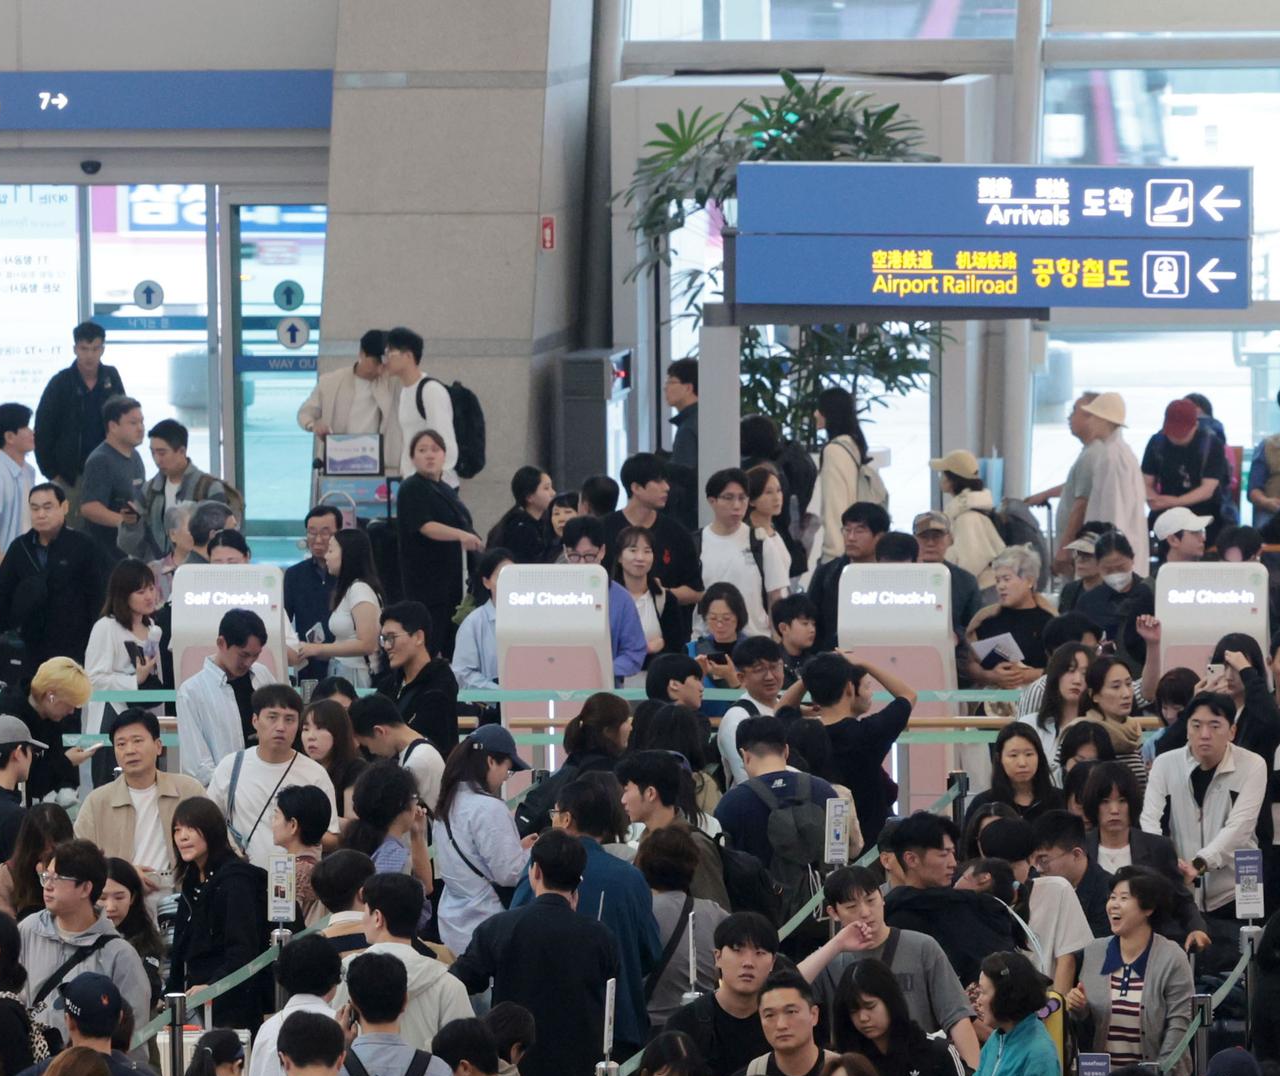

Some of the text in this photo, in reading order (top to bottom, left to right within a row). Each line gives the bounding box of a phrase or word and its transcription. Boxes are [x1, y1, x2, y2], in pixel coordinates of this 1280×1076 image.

[39, 92, 50, 109] 7
[1082, 187, 1134, 218] 도착
[985, 204, 1070, 226] Arrivals
[1031, 258, 1131, 289] 공항철도
[872, 274, 1018, 298] Airport Railroad
[269, 358, 318, 369] WAY OU
[183, 591, 270, 606] Self Check-in
[508, 591, 595, 606] Self Check-in
[850, 590, 937, 605] Self Check-in
[1167, 589, 1256, 605] Self Check-in
